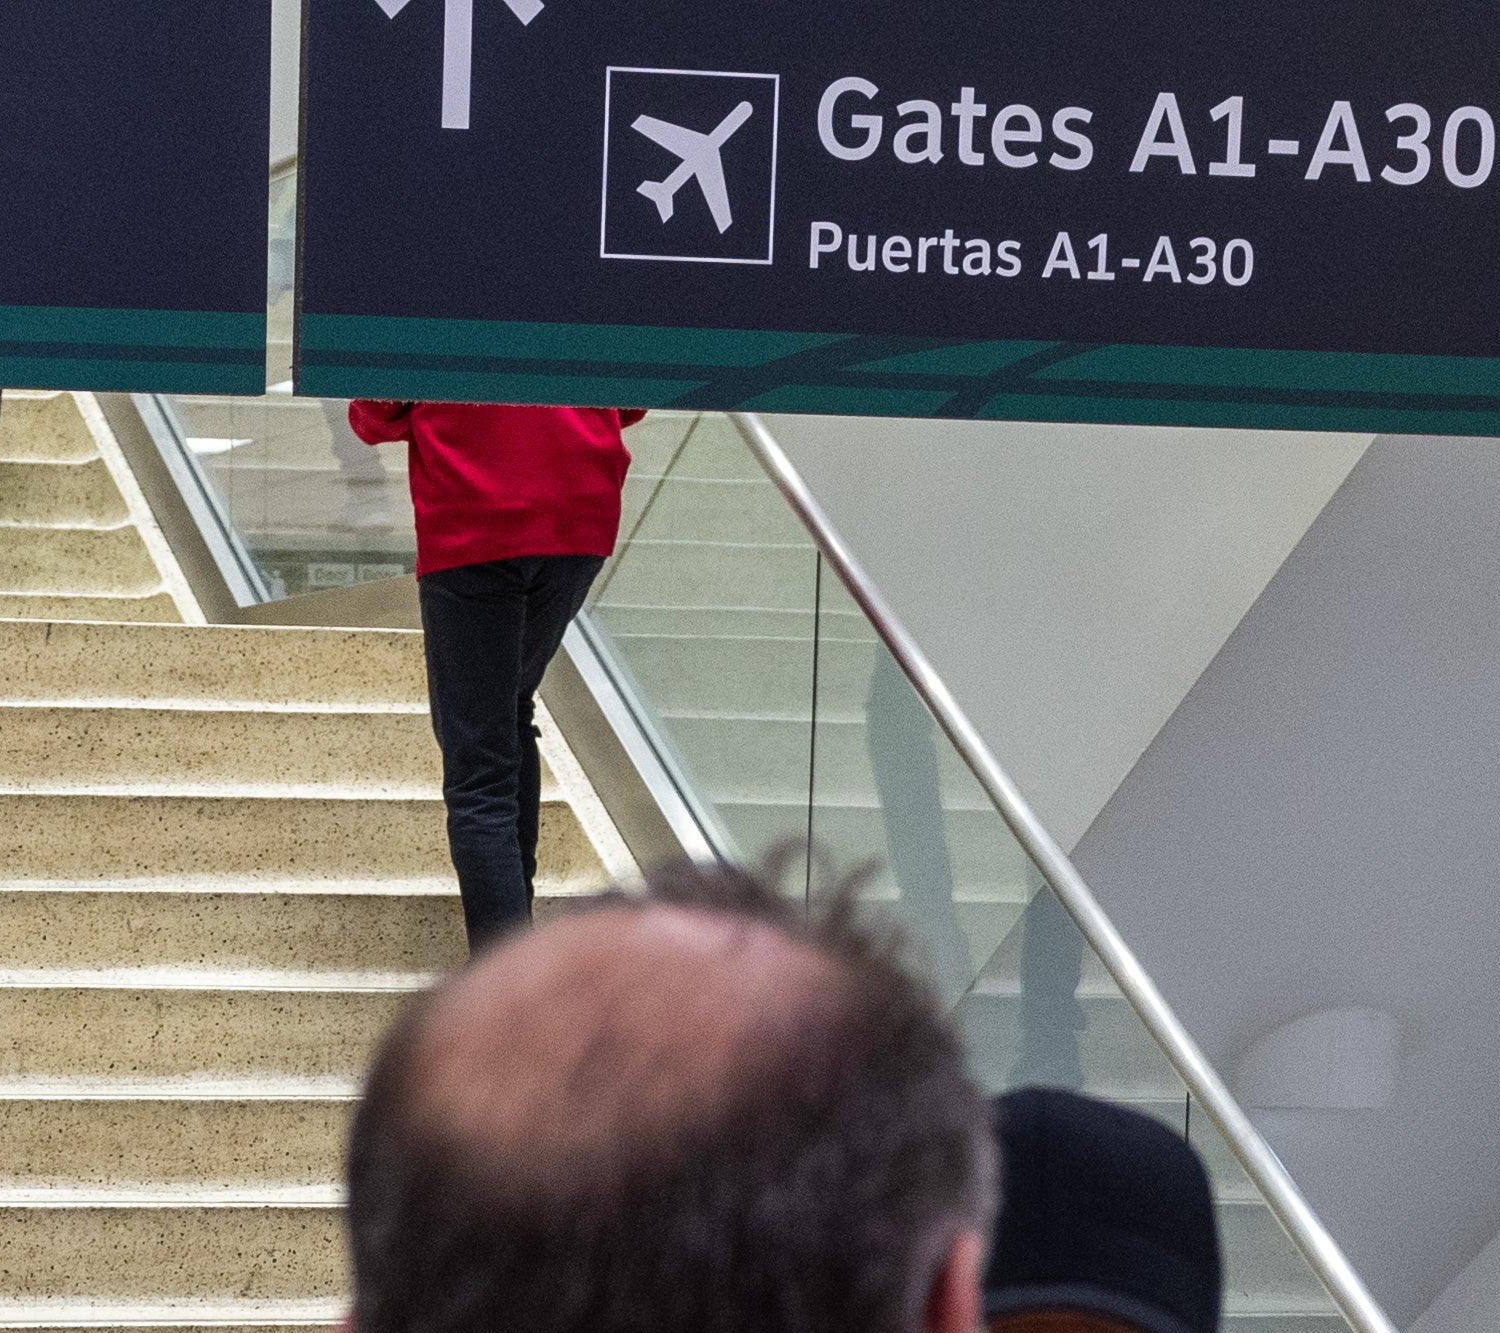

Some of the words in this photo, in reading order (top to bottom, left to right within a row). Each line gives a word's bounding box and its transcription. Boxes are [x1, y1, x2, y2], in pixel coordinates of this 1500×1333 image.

[817, 76, 1094, 171] Gates
[1129, 92, 1496, 189] A1-A30
[809, 221, 1022, 278] Puertas
[1041, 231, 1254, 287] A1-A30
